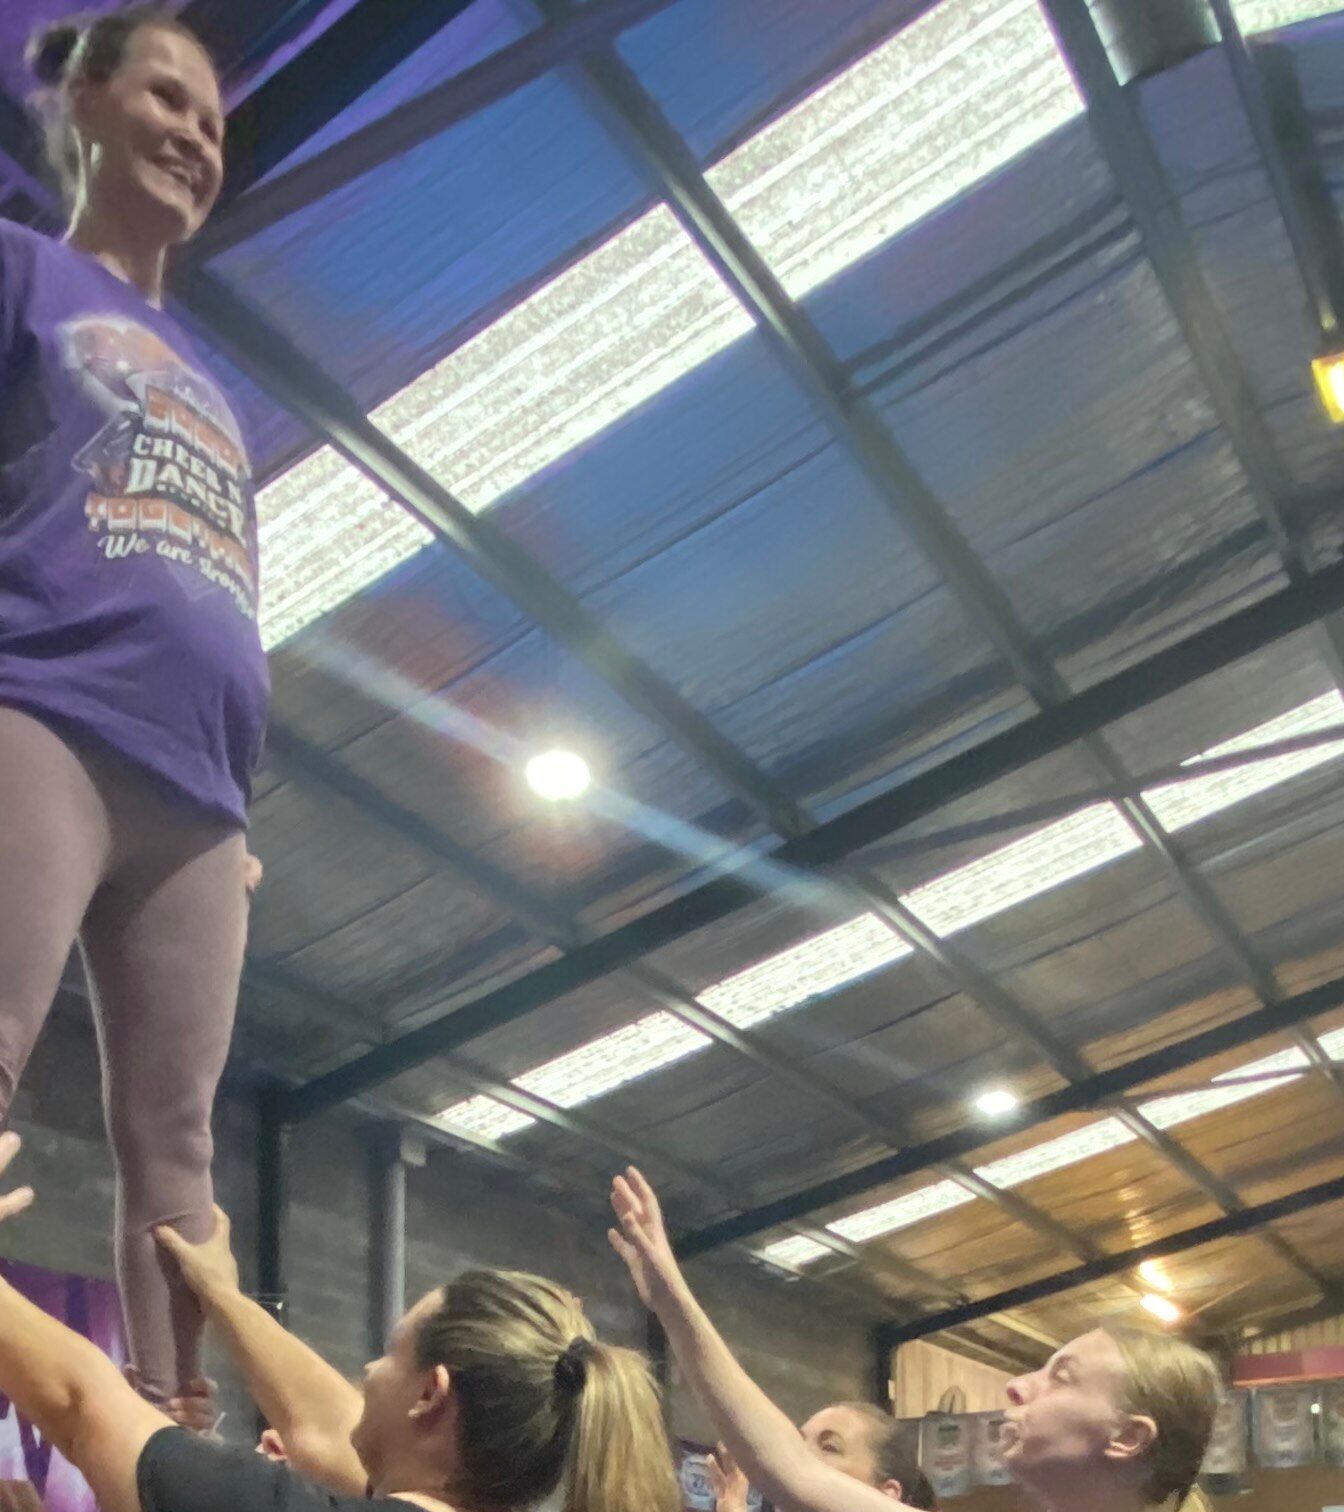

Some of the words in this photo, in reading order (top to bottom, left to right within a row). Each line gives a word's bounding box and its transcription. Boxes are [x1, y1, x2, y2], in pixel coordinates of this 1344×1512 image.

[133, 433, 222, 493] CHEER
[124, 458, 247, 549] DANCE
[97, 533, 150, 559] We
[156, 540, 193, 564] are
